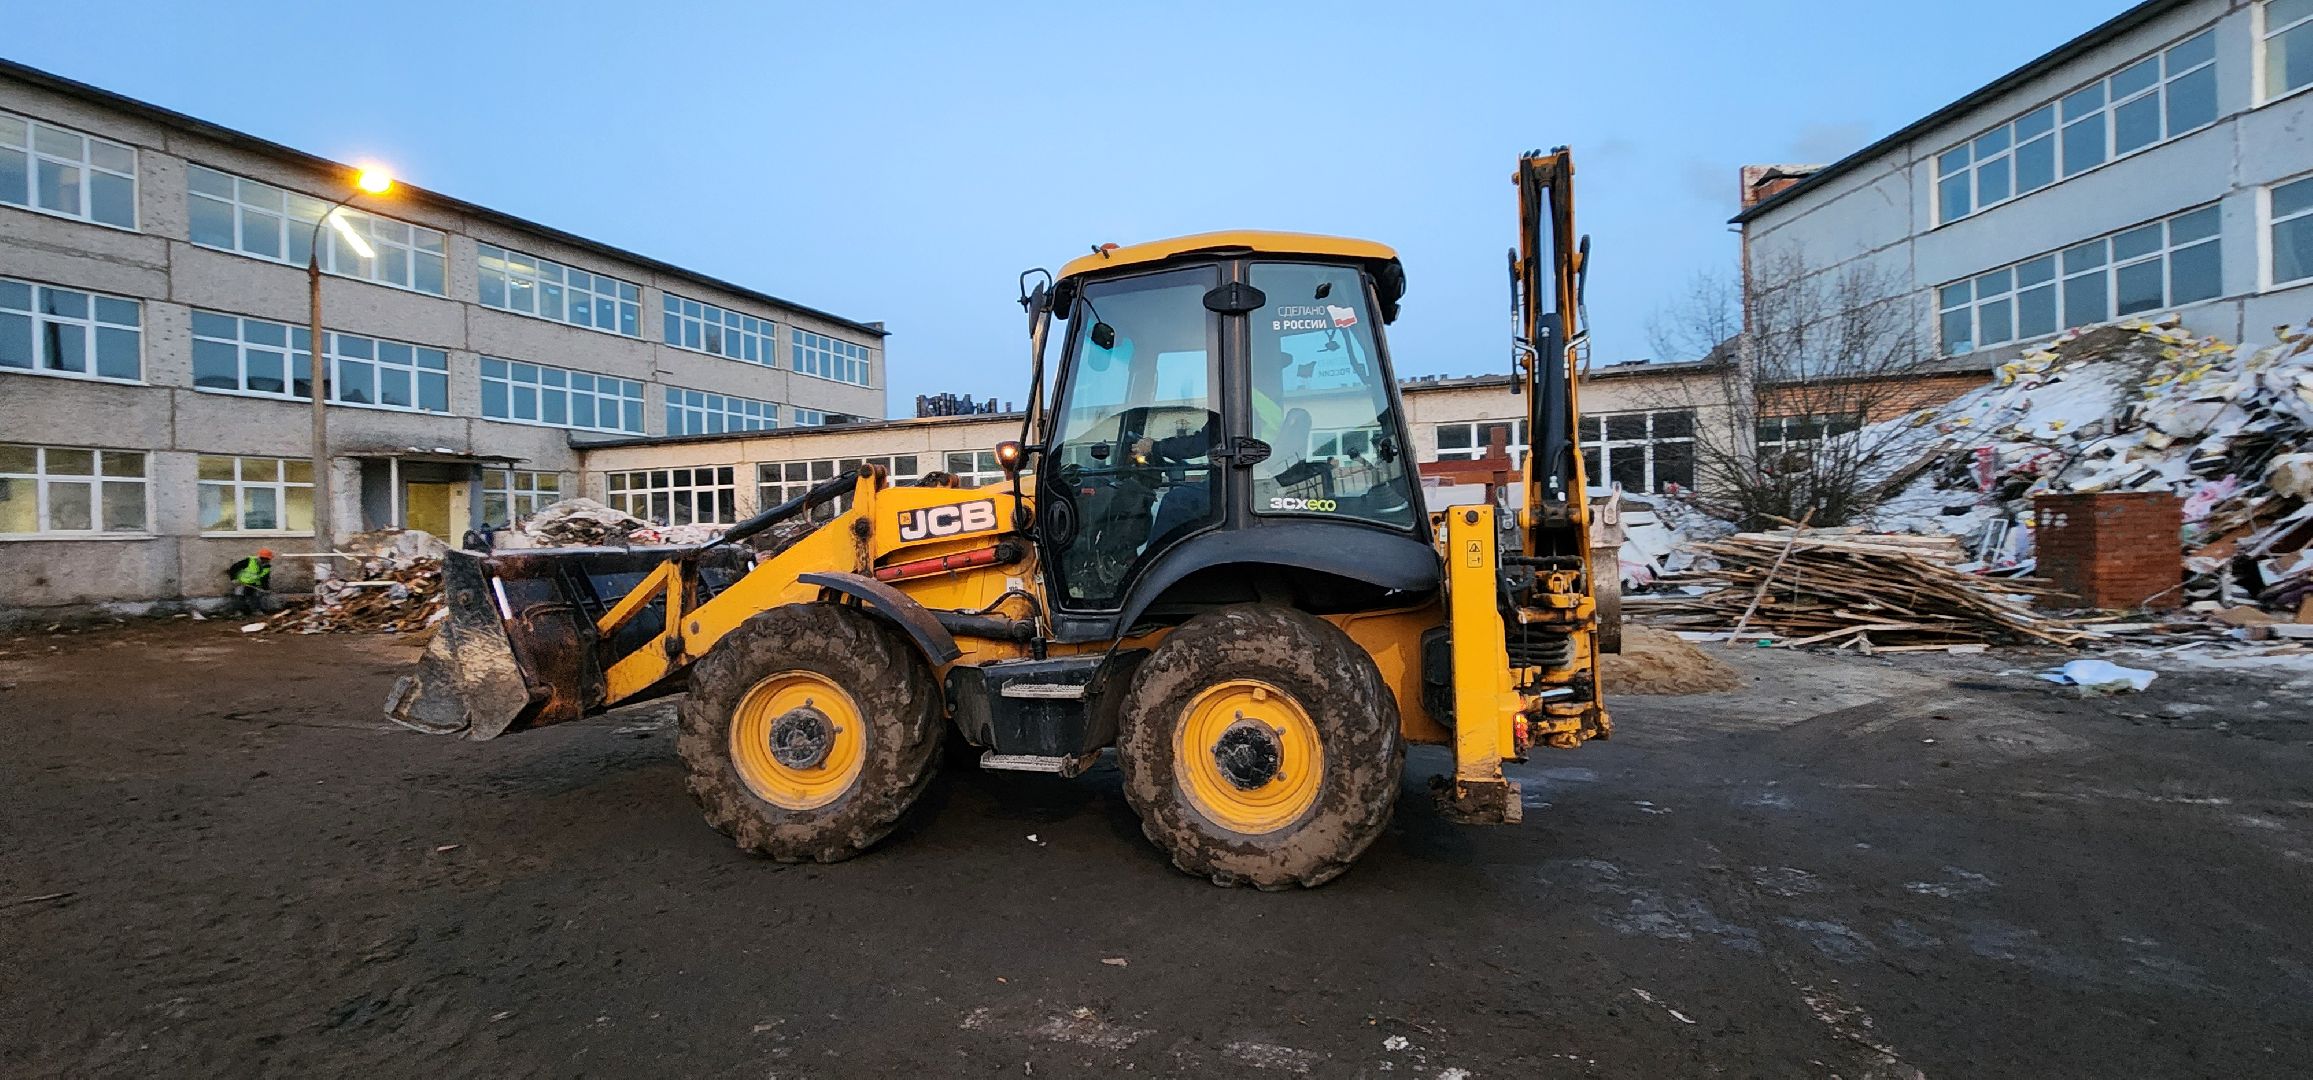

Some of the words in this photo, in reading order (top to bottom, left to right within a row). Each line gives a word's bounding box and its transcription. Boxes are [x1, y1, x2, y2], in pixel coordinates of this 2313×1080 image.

[1278, 306, 1326, 317] СДЕЛАНО
[1272, 320, 1281, 330] В
[1283, 319, 1327, 330] РОССИИ
[901, 501, 997, 540] JCB
